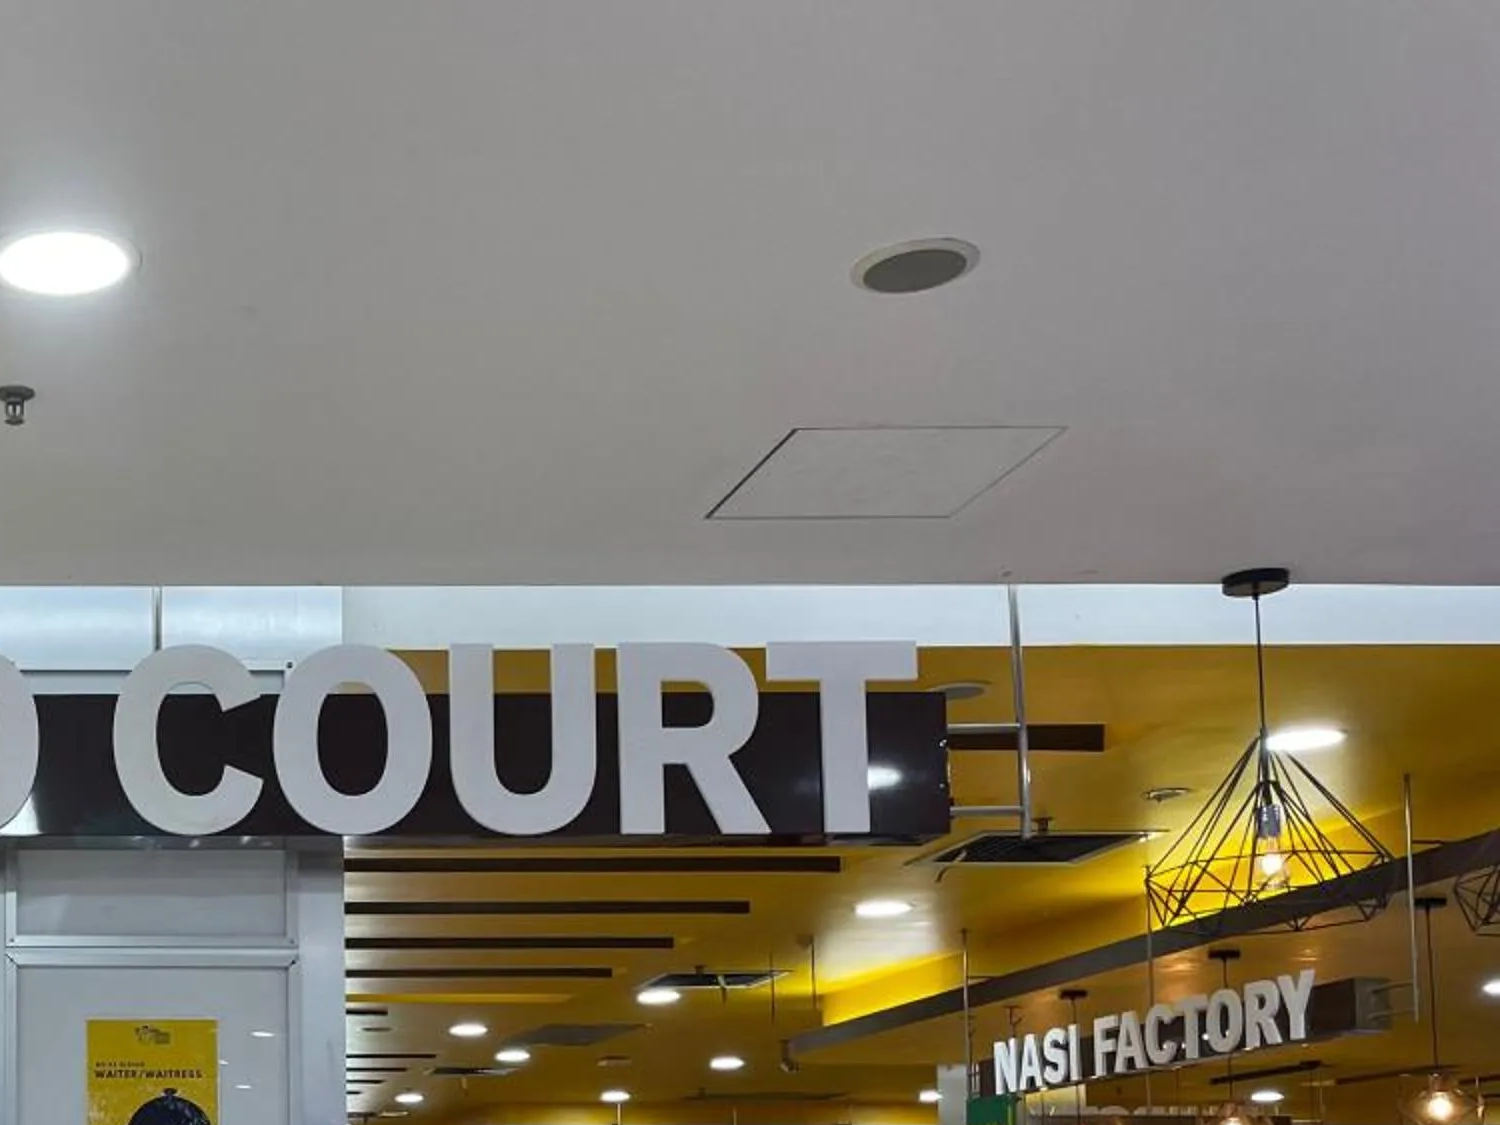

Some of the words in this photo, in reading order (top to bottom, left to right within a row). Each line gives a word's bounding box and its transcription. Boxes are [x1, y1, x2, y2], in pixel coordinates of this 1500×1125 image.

[112, 639, 917, 837] COURT
[993, 1023, 1082, 1095] NASI
[1093, 969, 1315, 1077] FACTORY
